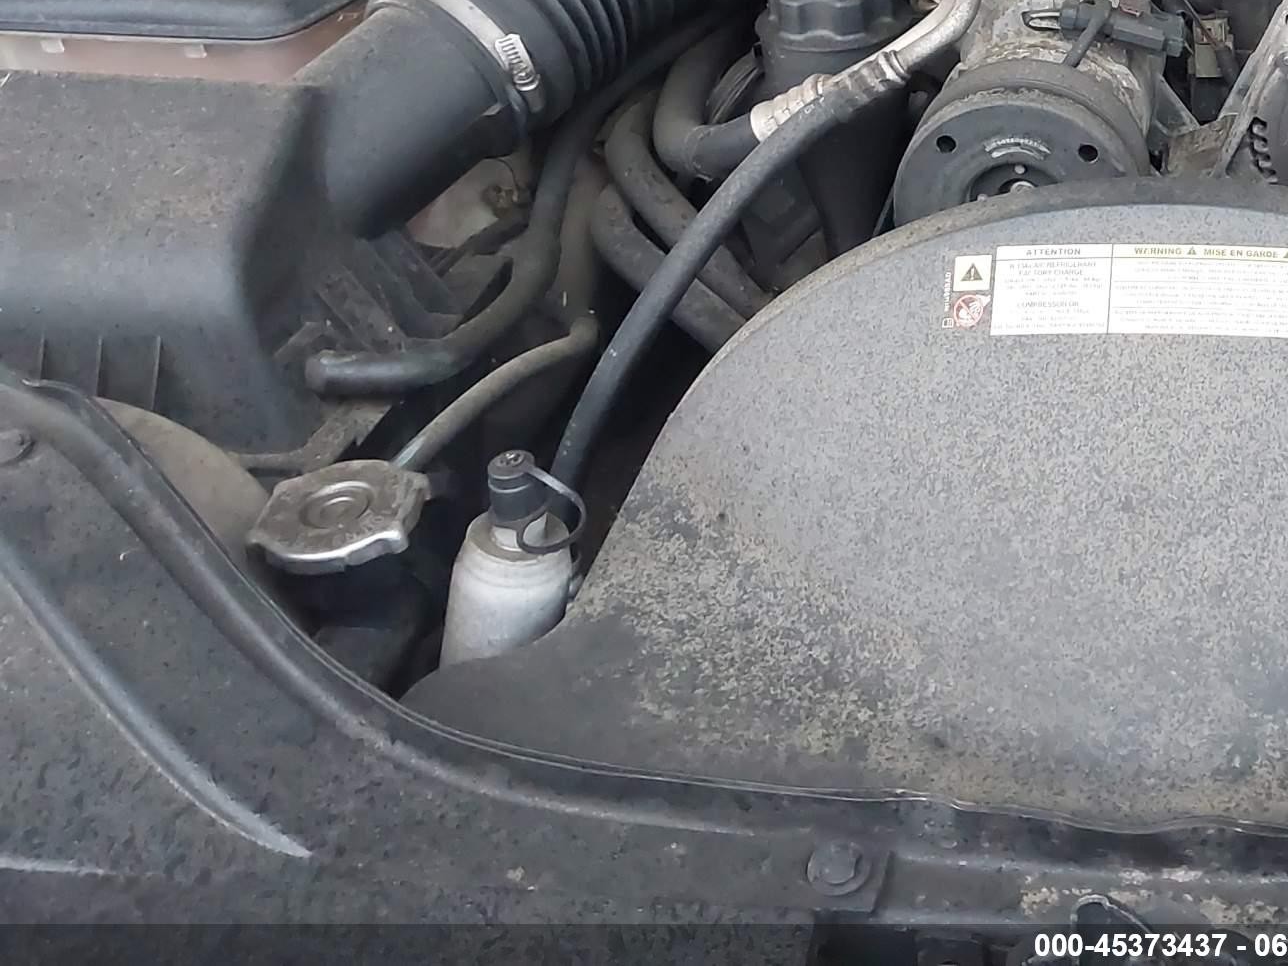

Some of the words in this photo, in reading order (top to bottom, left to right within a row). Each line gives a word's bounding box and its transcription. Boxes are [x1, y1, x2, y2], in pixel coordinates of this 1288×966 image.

[1026, 247, 1081, 256] ATTENTION
[1134, 246, 1182, 256] WARNING
[1203, 248, 1227, 257] MISE
[1230, 248, 1243, 257] EN
[1246, 249, 1279, 259] GARDE
